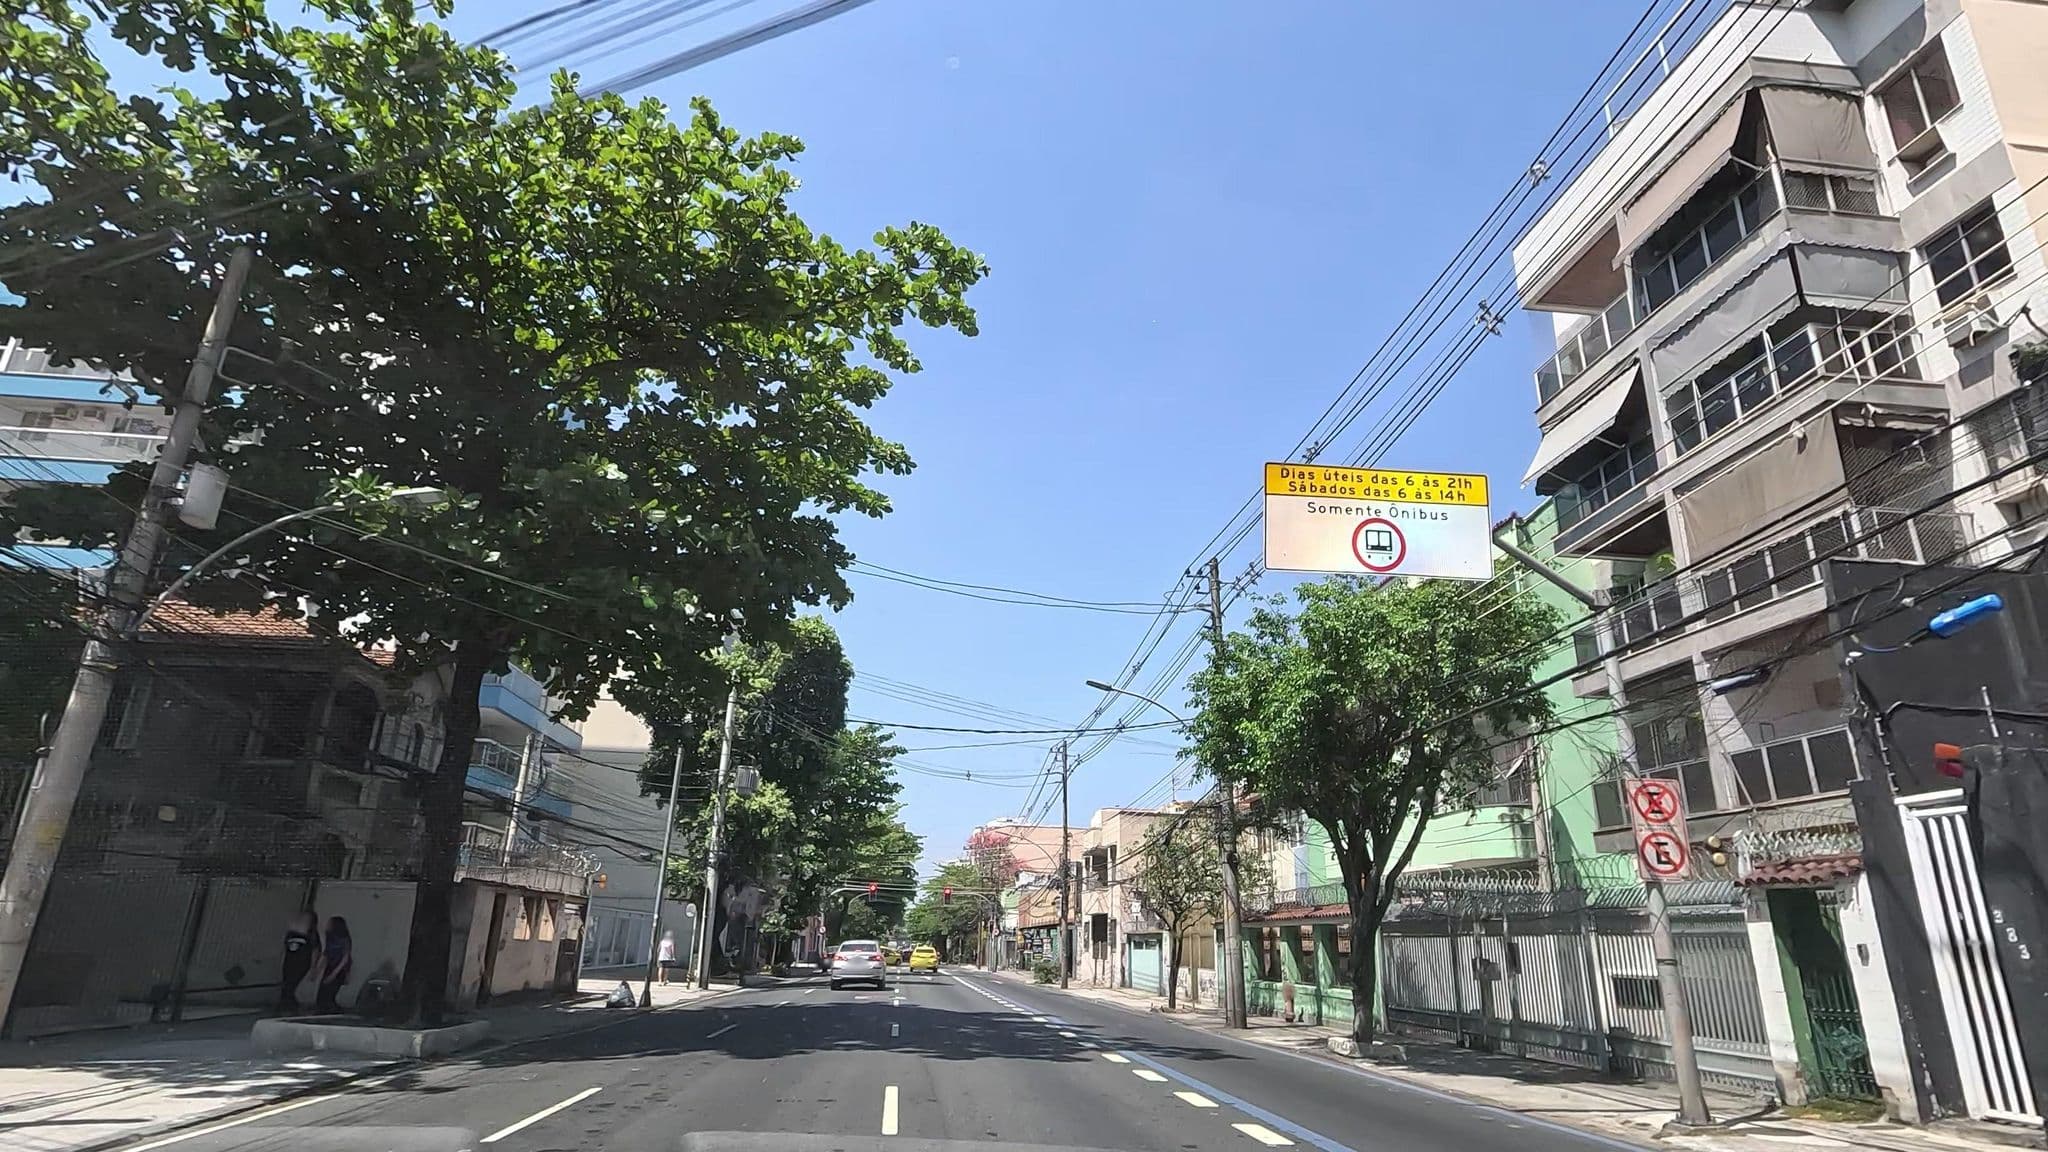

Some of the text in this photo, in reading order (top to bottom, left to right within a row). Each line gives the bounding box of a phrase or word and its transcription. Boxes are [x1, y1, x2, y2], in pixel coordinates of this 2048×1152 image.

[1281, 467, 1472, 489] Dias úteis das 6 às 21h
[1288, 481, 1465, 501] Sábados das 6 às 14h
[1307, 501, 1448, 520] Somente Ônibus
[1654, 841, 1672, 864] E
